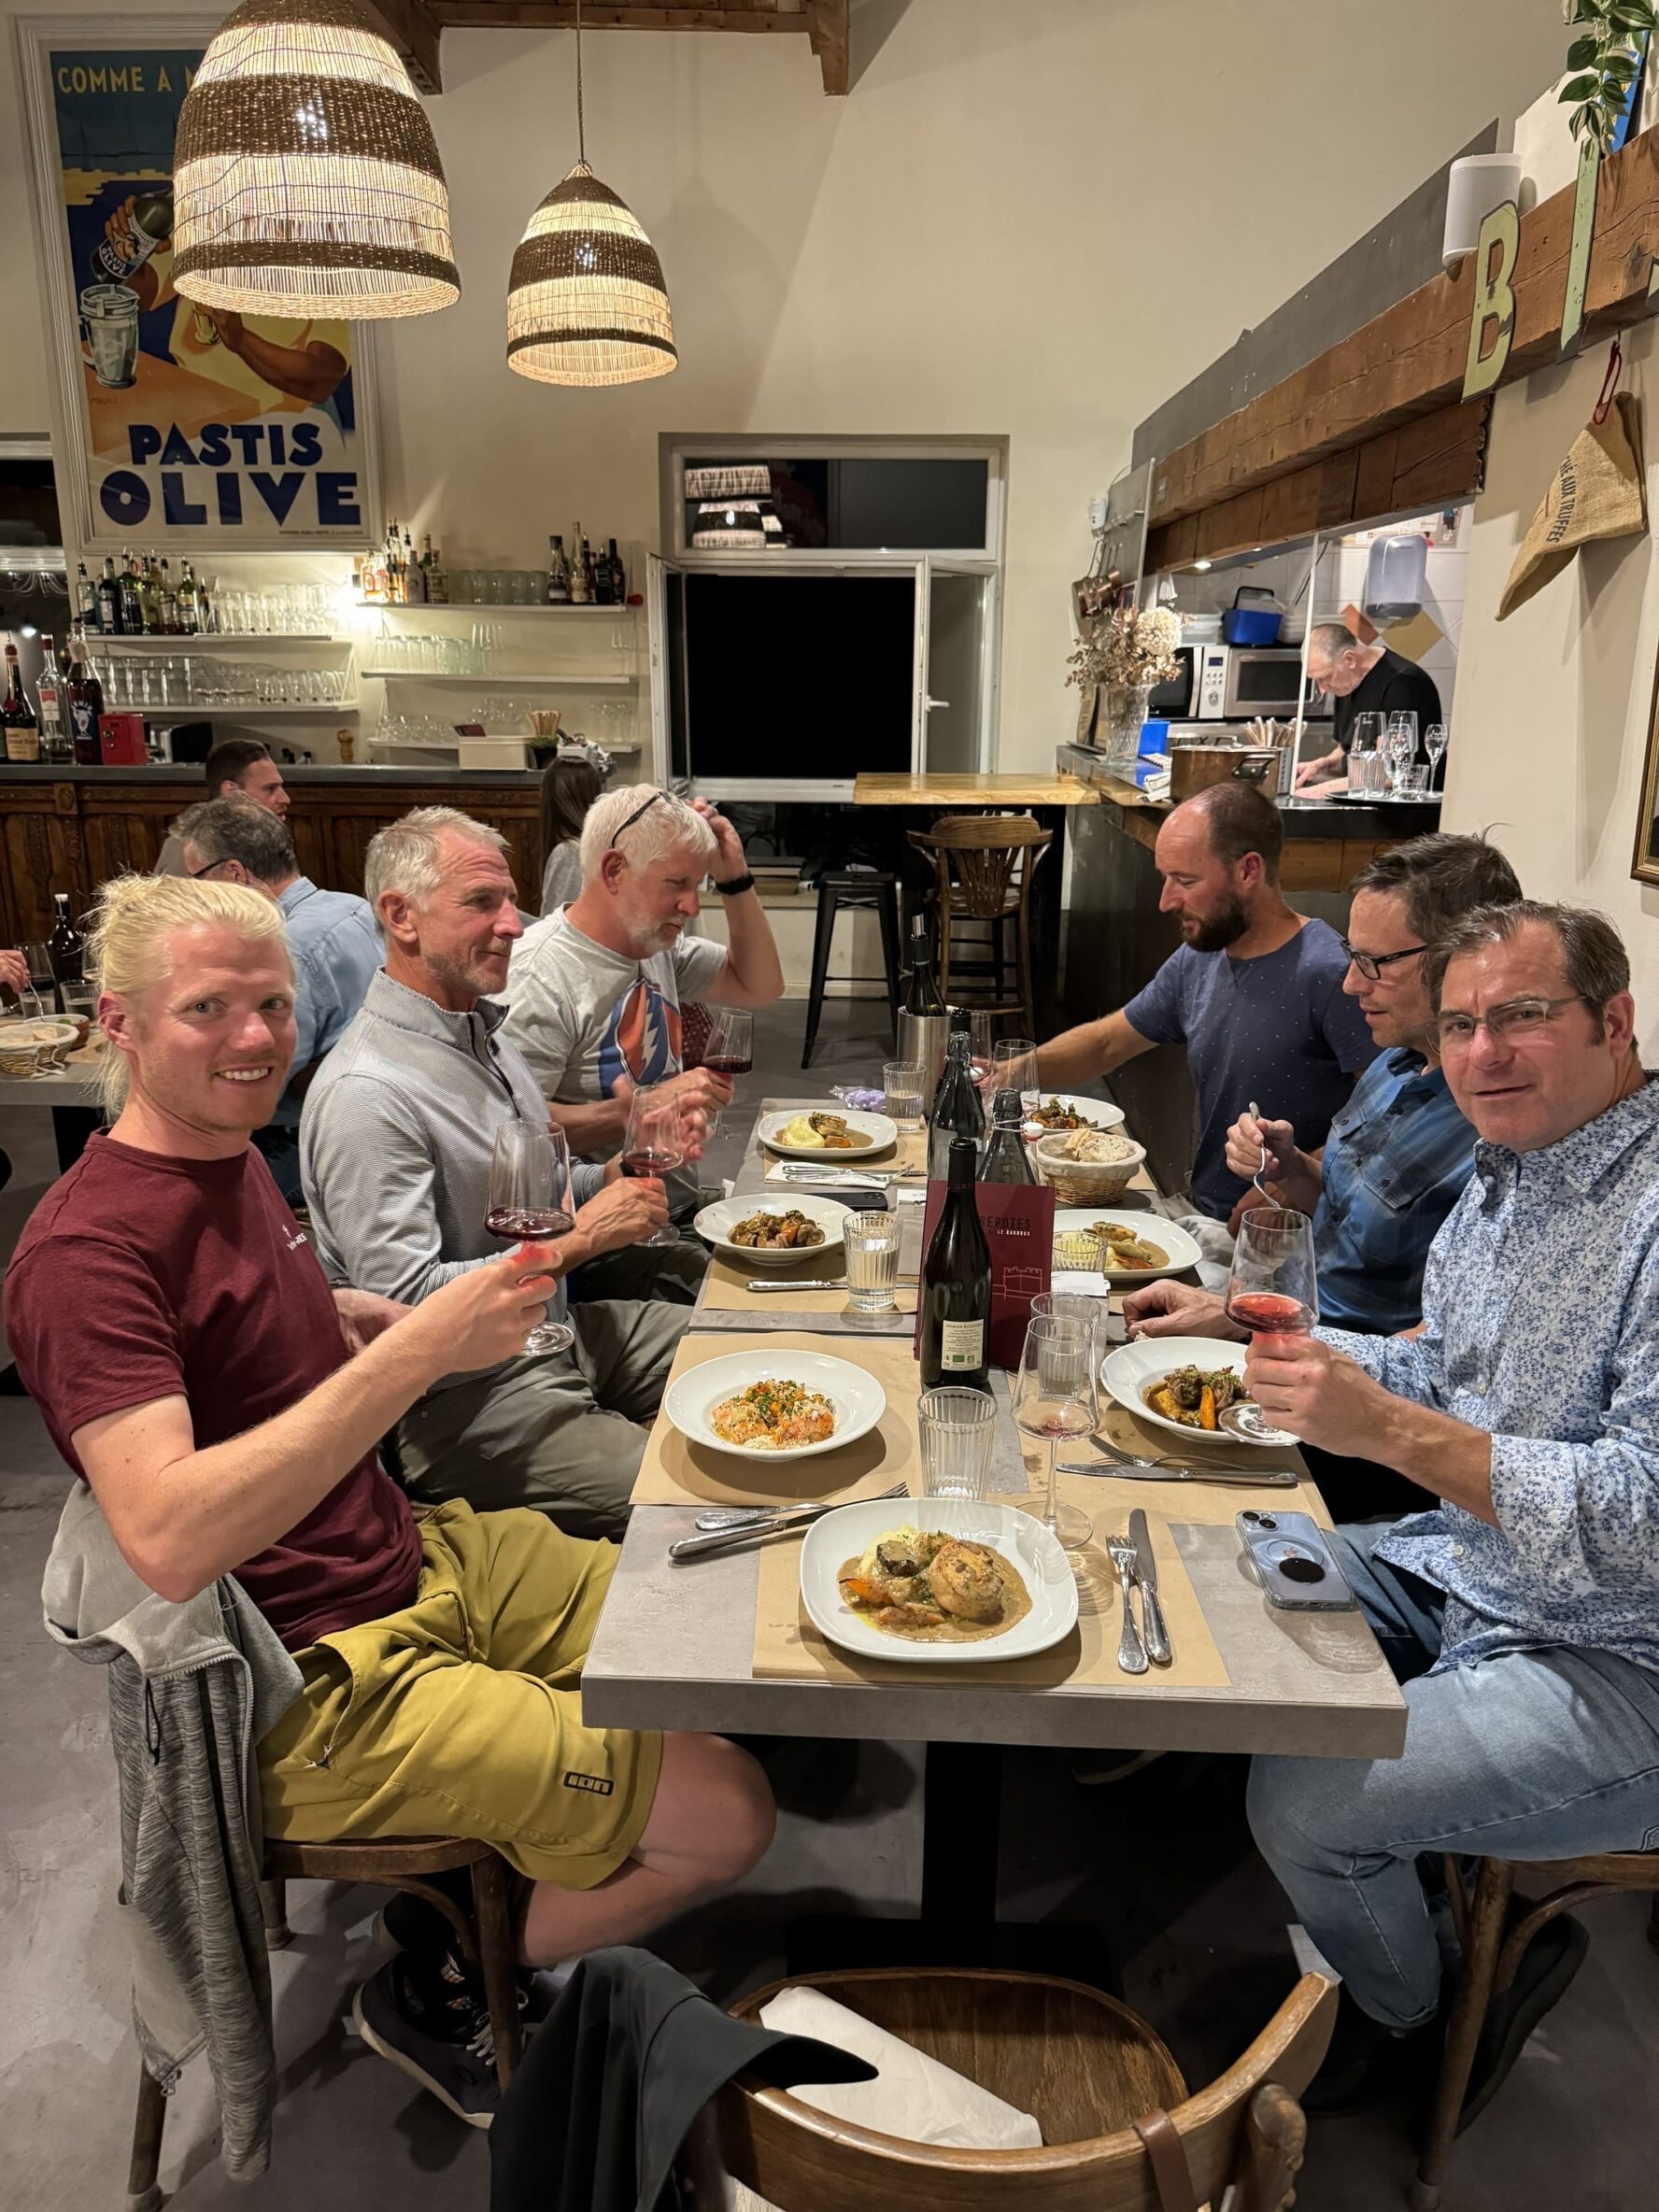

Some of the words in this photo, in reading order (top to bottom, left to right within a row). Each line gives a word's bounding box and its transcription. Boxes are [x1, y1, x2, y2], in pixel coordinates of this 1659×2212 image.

[57, 66, 144, 93] COMME
[157, 65, 172, 92] A
[102, 248, 124, 275] OLIVE
[128, 422, 322, 466] PASTIS
[100, 470, 362, 527] OLIVE
[1561, 475, 1576, 499] AUX
[1546, 498, 1575, 544] TRUFFES
